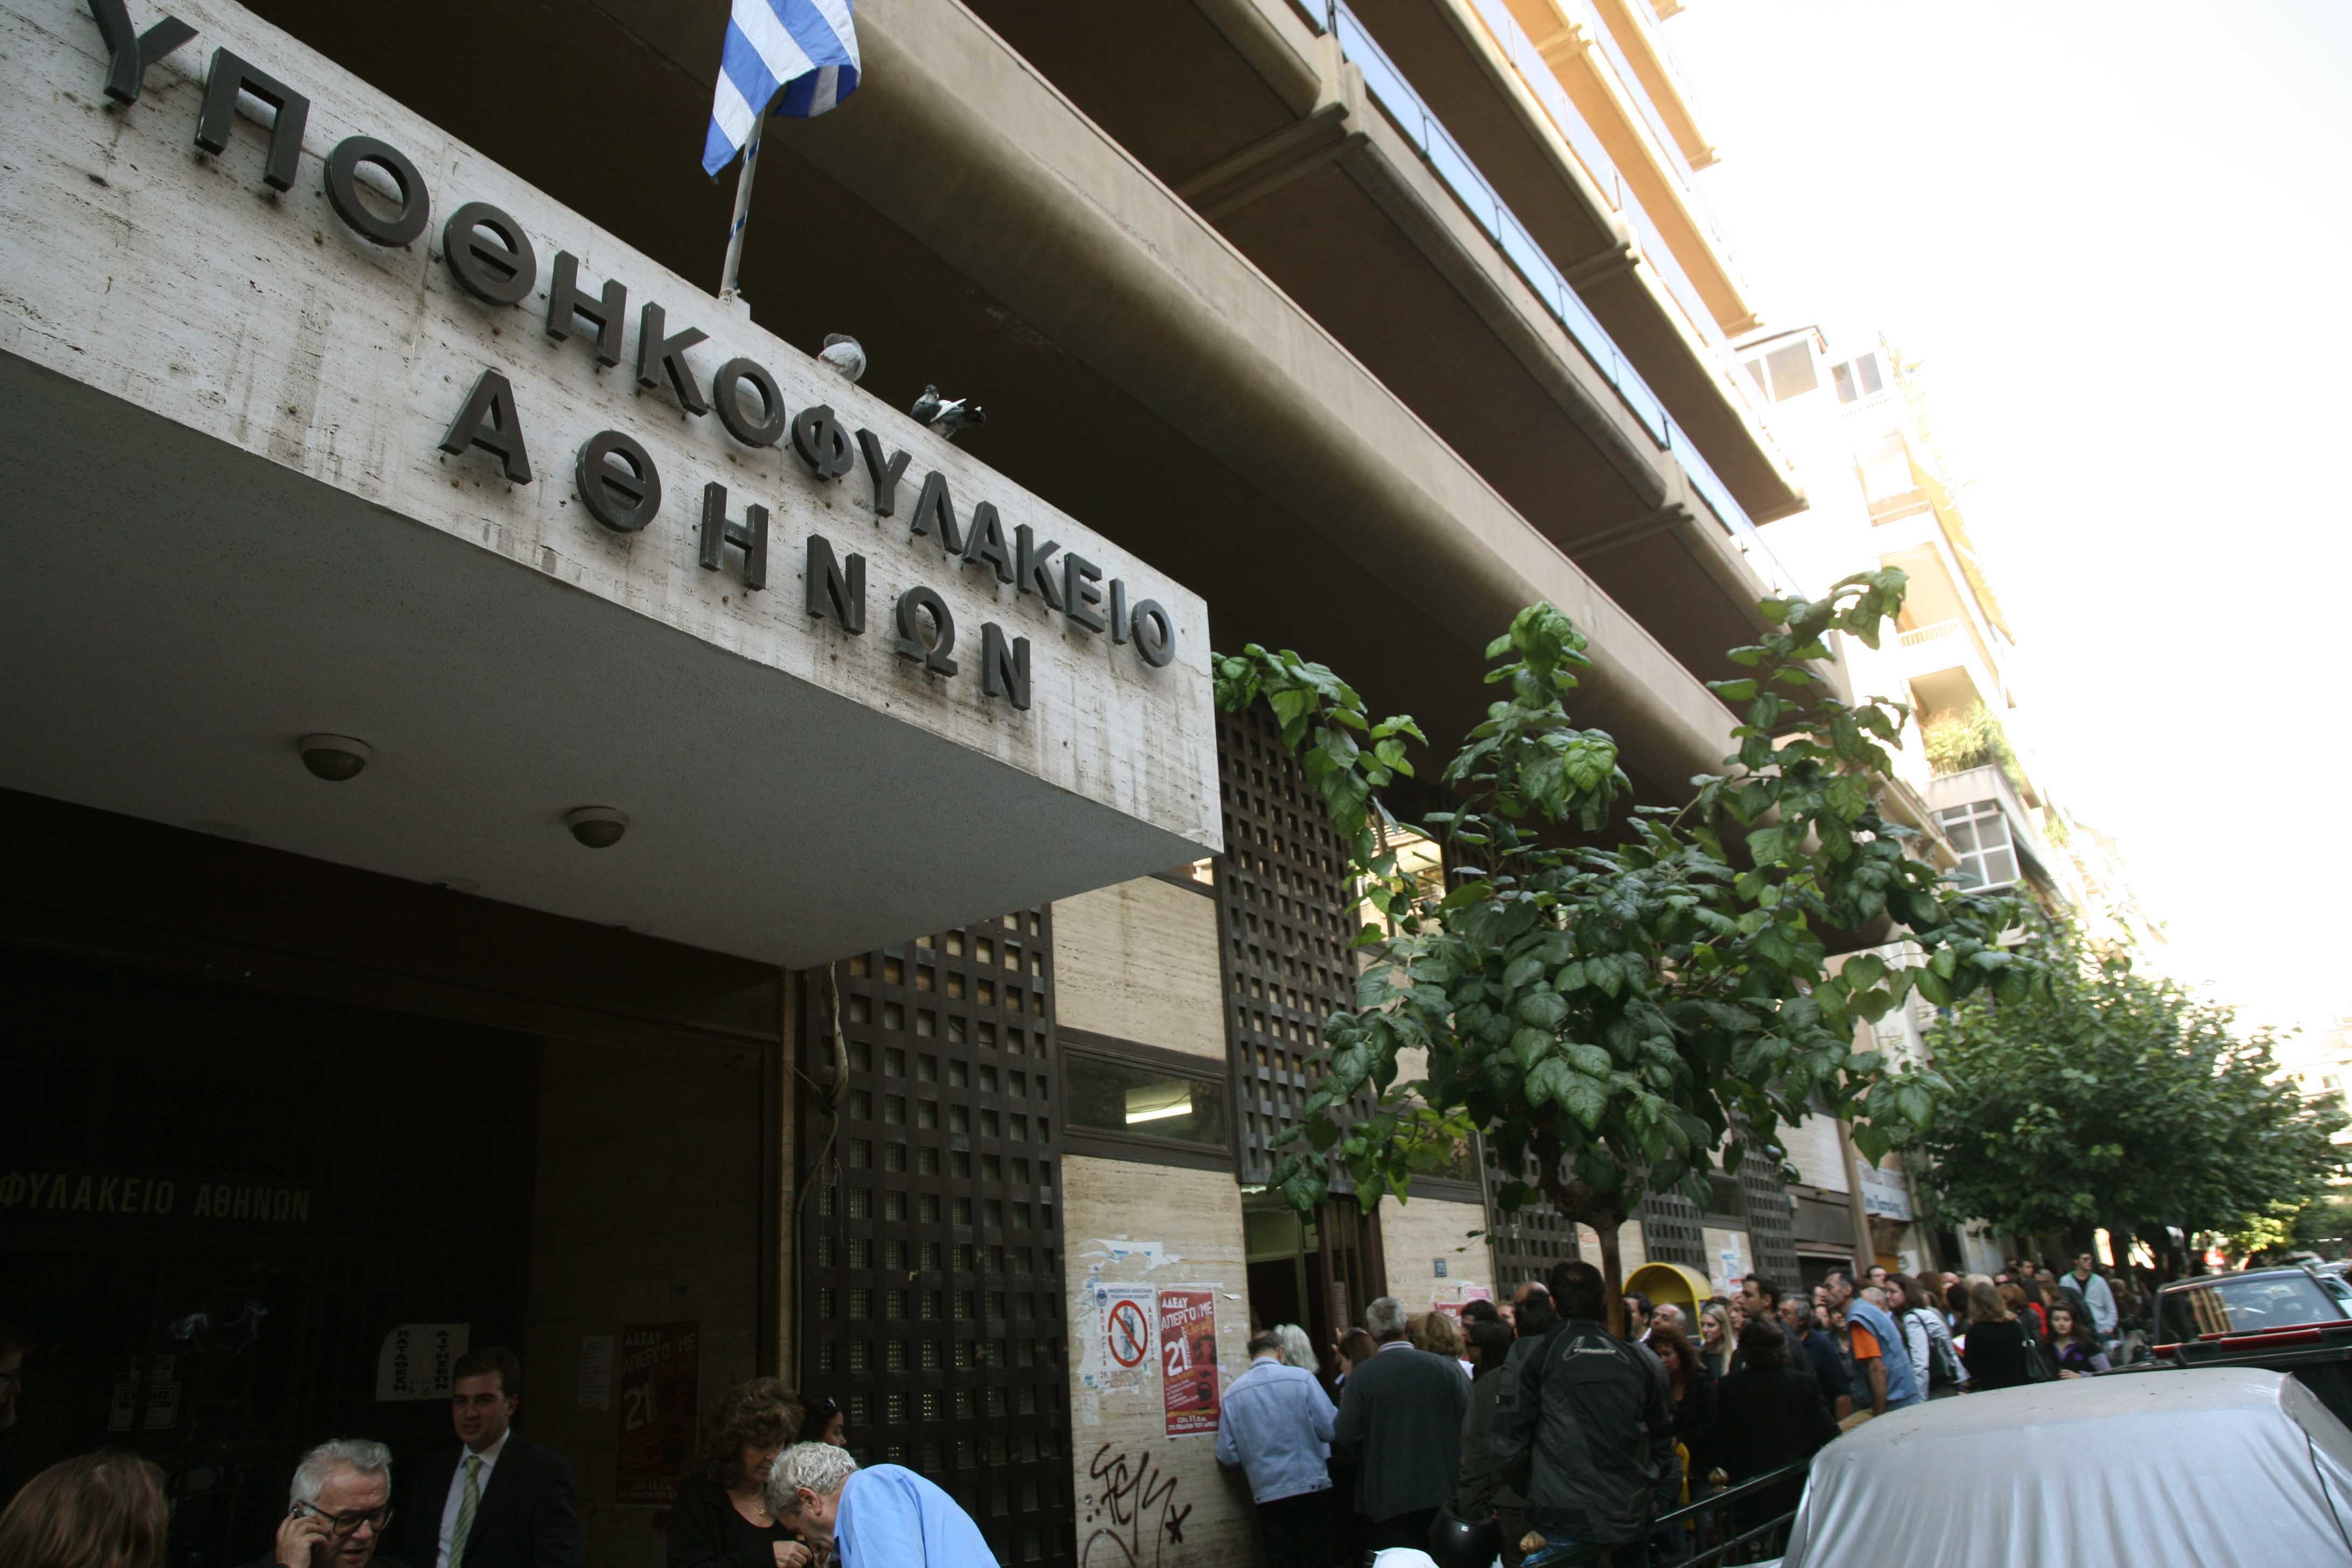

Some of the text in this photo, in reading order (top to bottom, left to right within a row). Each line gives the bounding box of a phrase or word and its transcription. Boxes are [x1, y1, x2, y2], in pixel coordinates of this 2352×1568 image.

[88, 0, 1175, 668] ΥΠΟΘΗΚΟΦΥΛΑΚΕΙΟ
[438, 369, 1031, 711] ΑΘΗΝΩΝ
[193, 1182, 311, 1222] ΑΘΗΝΩΝ
[1161, 1297, 1189, 1309] ΑΔΕΔΥ
[1164, 1336, 1189, 1377] 21
[624, 1382, 653, 1431] 21
